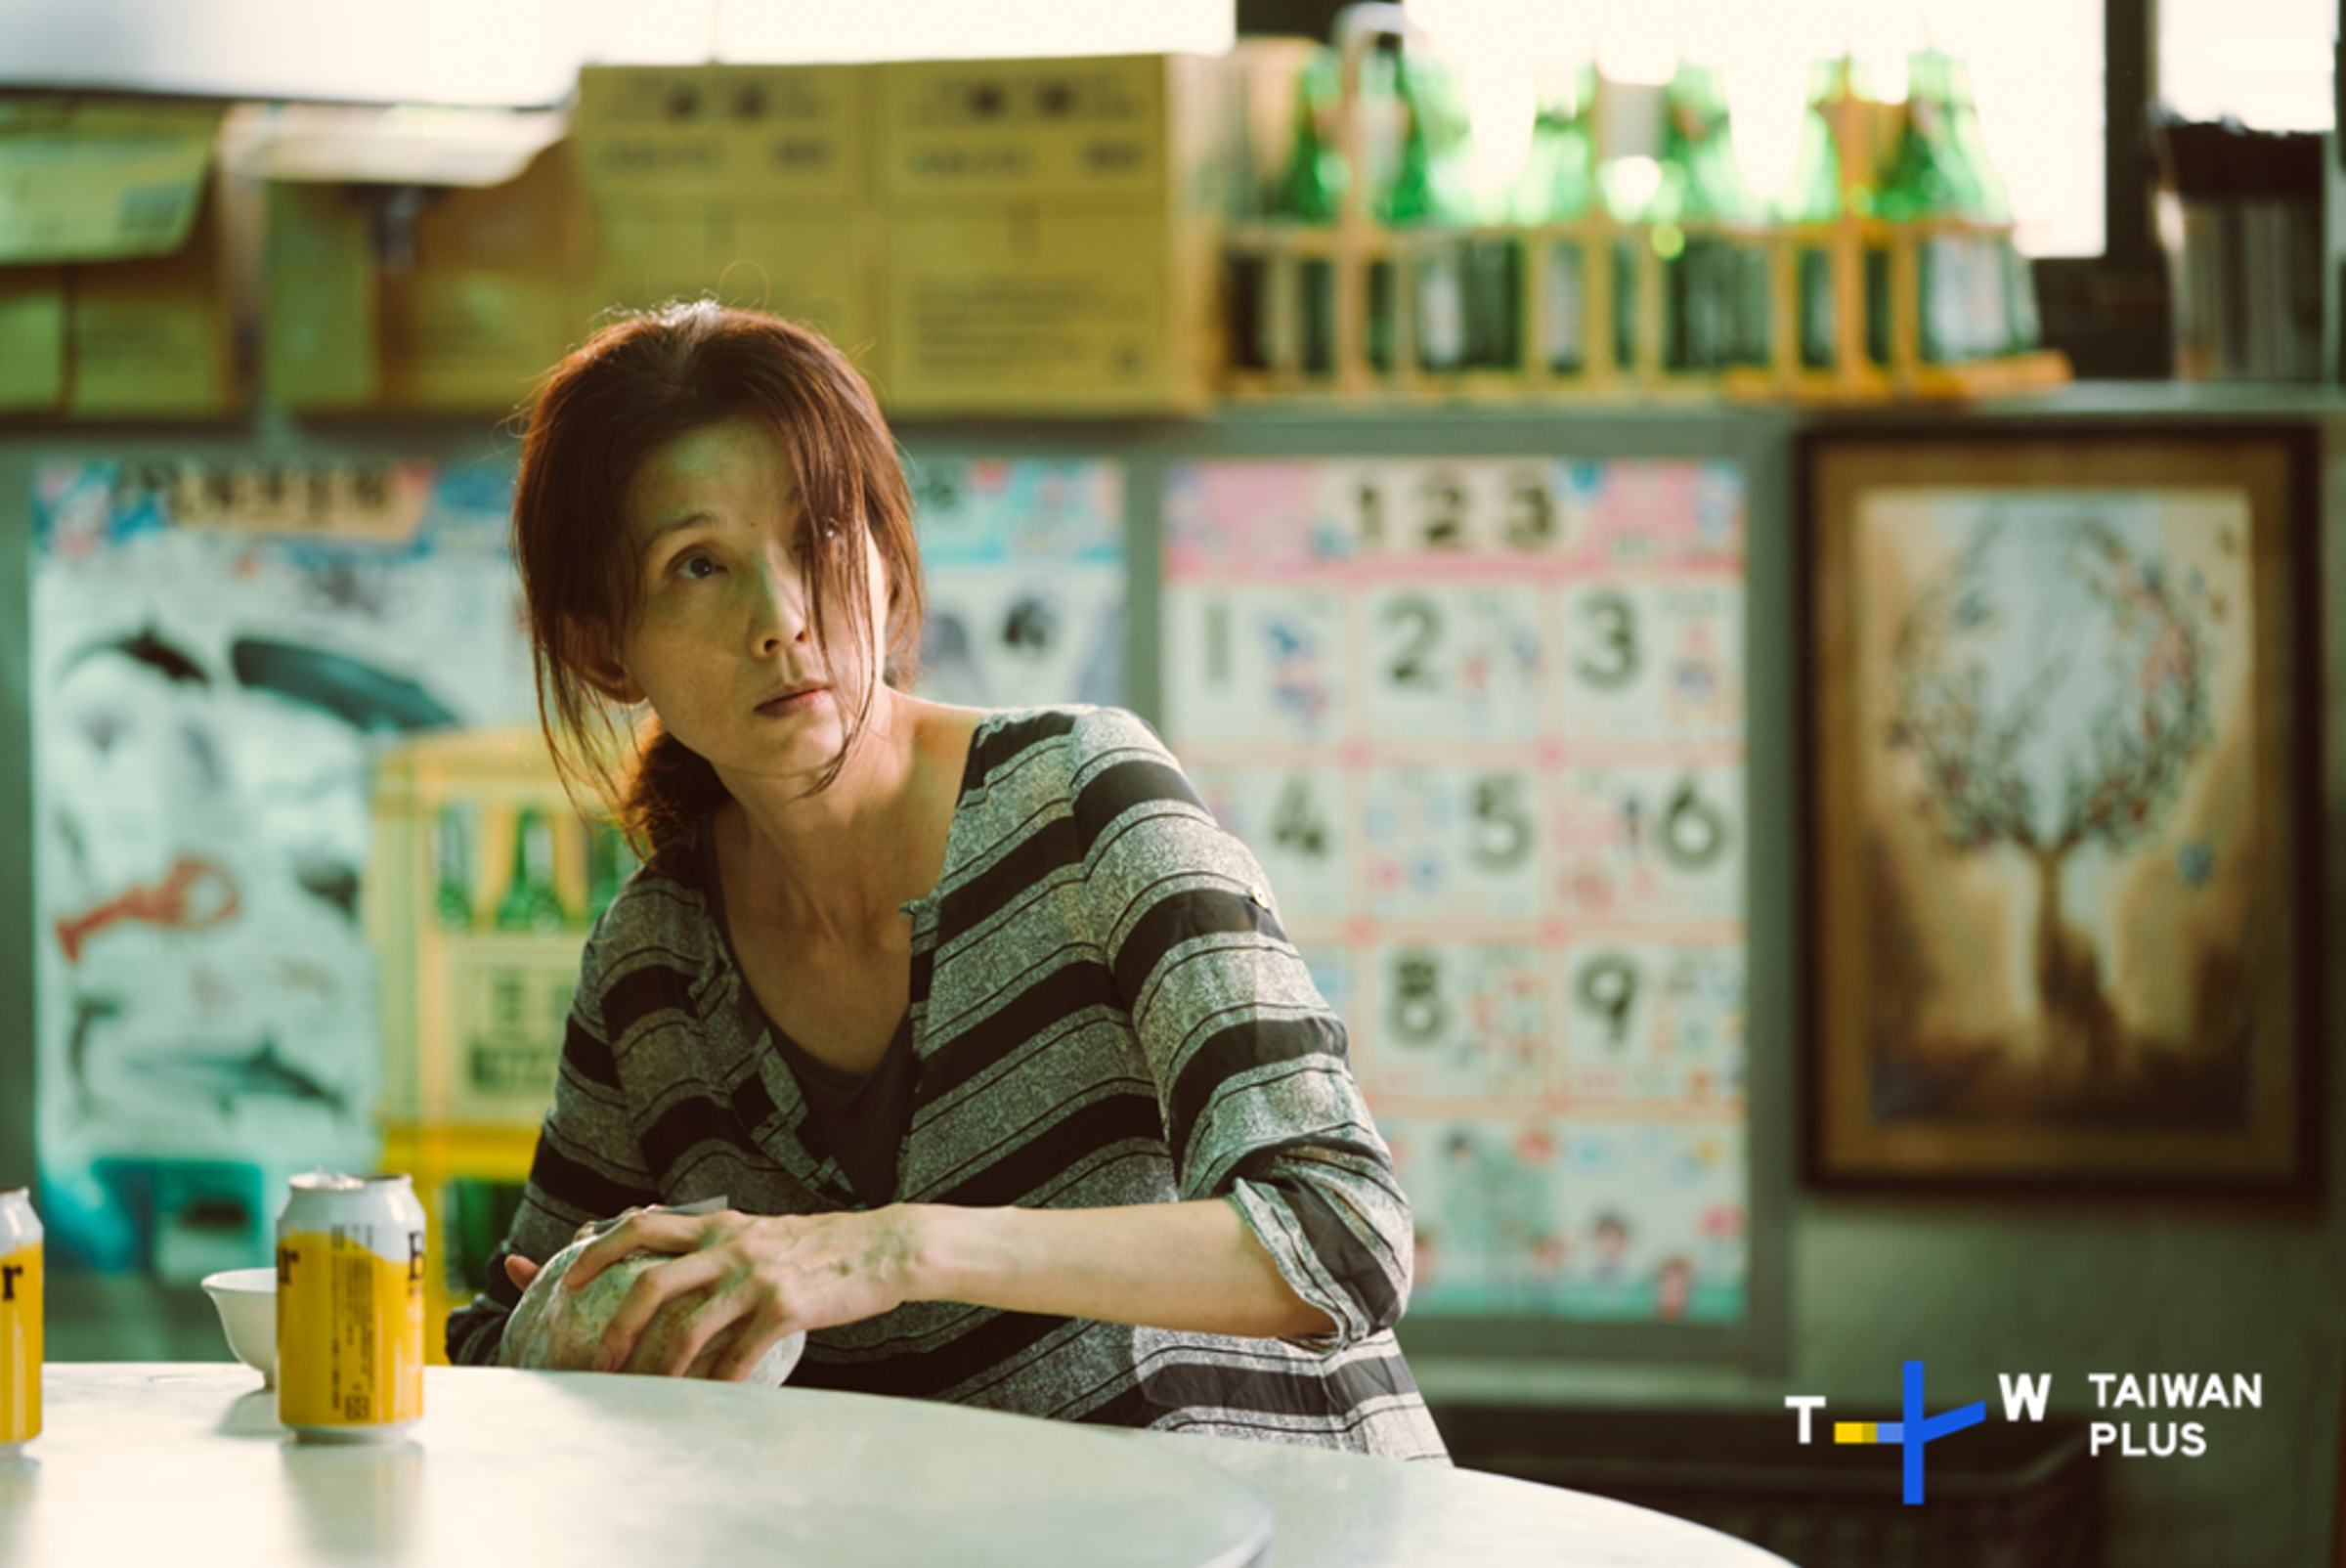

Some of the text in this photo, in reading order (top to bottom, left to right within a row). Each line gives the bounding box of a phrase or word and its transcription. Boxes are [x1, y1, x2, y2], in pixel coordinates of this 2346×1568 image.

[1353, 470, 1559, 550] 1 2 3
[1376, 590, 1444, 692] 2
[1570, 588, 1639, 692] 3
[1270, 777, 1330, 860] 4
[1470, 774, 1537, 871] 5
[1659, 772, 1727, 872] 6
[1386, 944, 1449, 1050] 8
[1575, 949, 1638, 1053] 9
